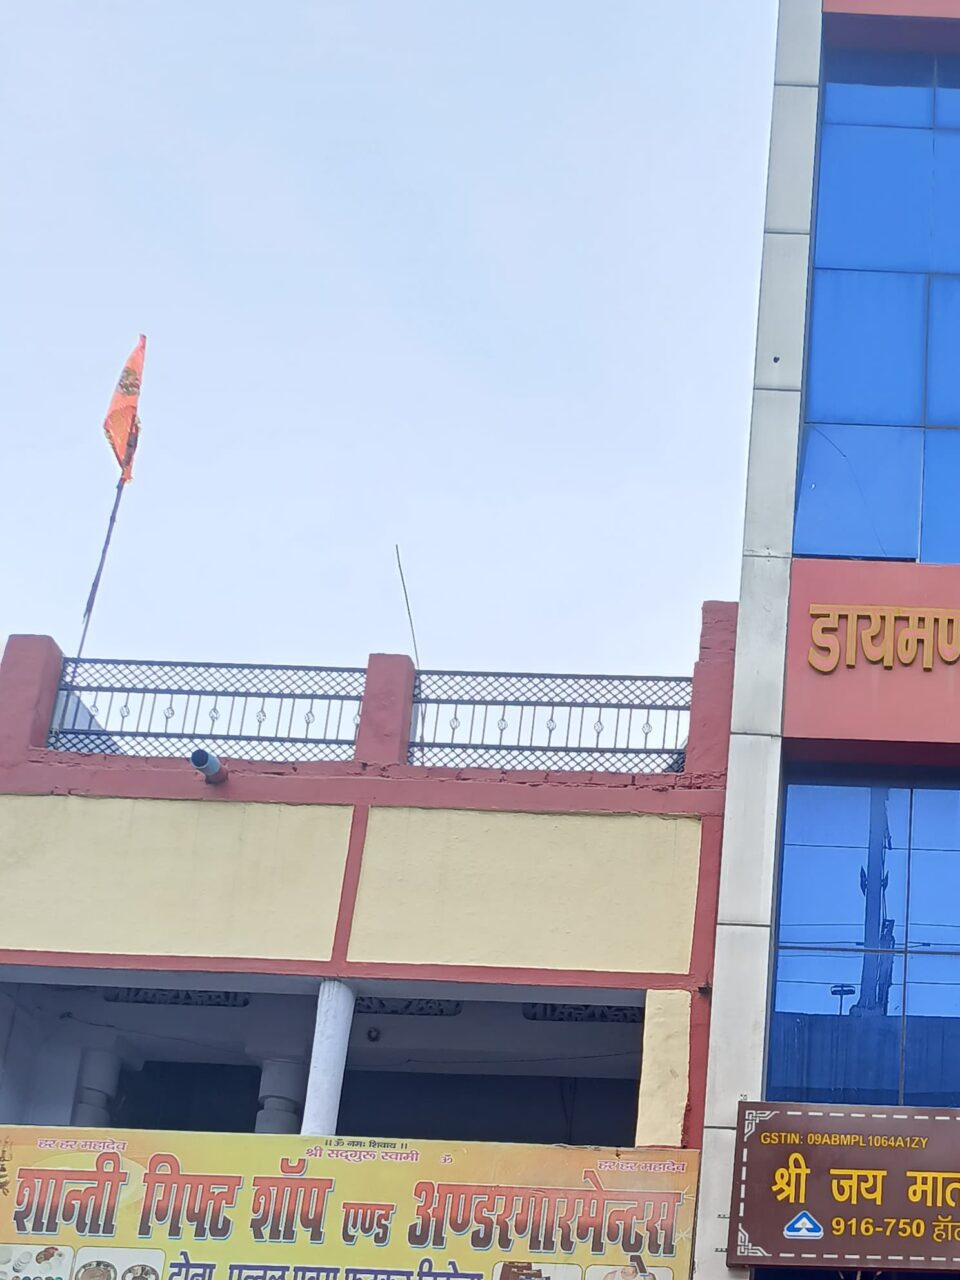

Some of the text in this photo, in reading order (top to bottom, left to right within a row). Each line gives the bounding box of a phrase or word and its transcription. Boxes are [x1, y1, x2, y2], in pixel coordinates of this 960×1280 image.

[80, 1139, 127, 1151] महादेव
[760, 1132, 928, 1149] GSTIN: 09ABMPL1064A1ZY
[306, 1148, 322, 1158] श्री
[381, 1150, 418, 1162] स्वामी
[641, 1160, 685, 1172] महादेव
[771, 1152, 811, 1204] श्री
[830, 1169, 887, 1206] जय
[14, 1152, 128, 1234] शान्ती
[138, 1153, 242, 1239] गिफ्ट
[250, 1158, 333, 1242] शॉप
[342, 1202, 395, 1245] एण्ड
[831, 1217, 925, 1236] 916-750
